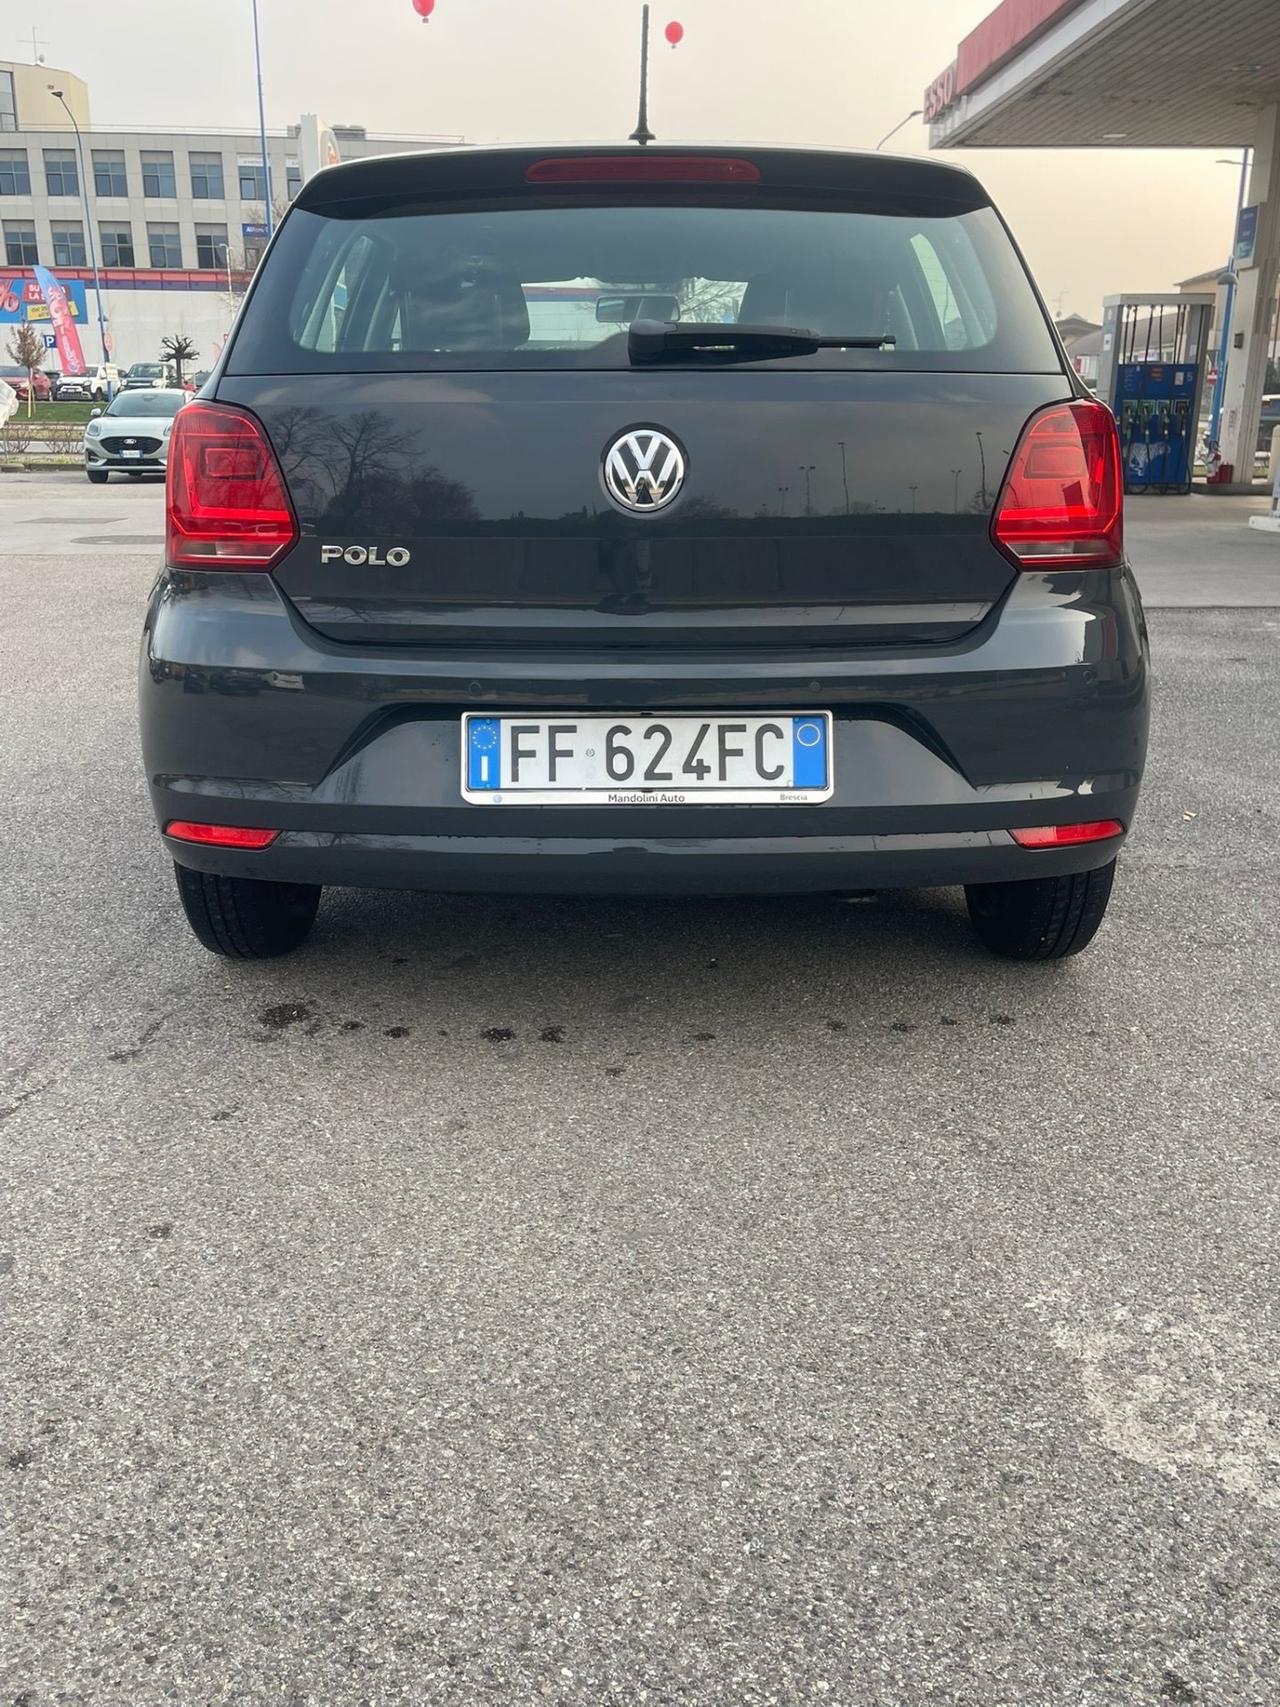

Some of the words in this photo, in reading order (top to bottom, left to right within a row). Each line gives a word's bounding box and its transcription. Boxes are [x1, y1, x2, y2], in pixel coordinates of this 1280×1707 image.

[46, 336, 55, 347] P
[321, 545, 411, 567] POLO
[511, 725, 577, 782] FF
[605, 724, 784, 782] 624FC
[608, 794, 658, 803] Mandolini
[661, 794, 685, 803] Auto
[780, 793, 808, 801] Brescia
